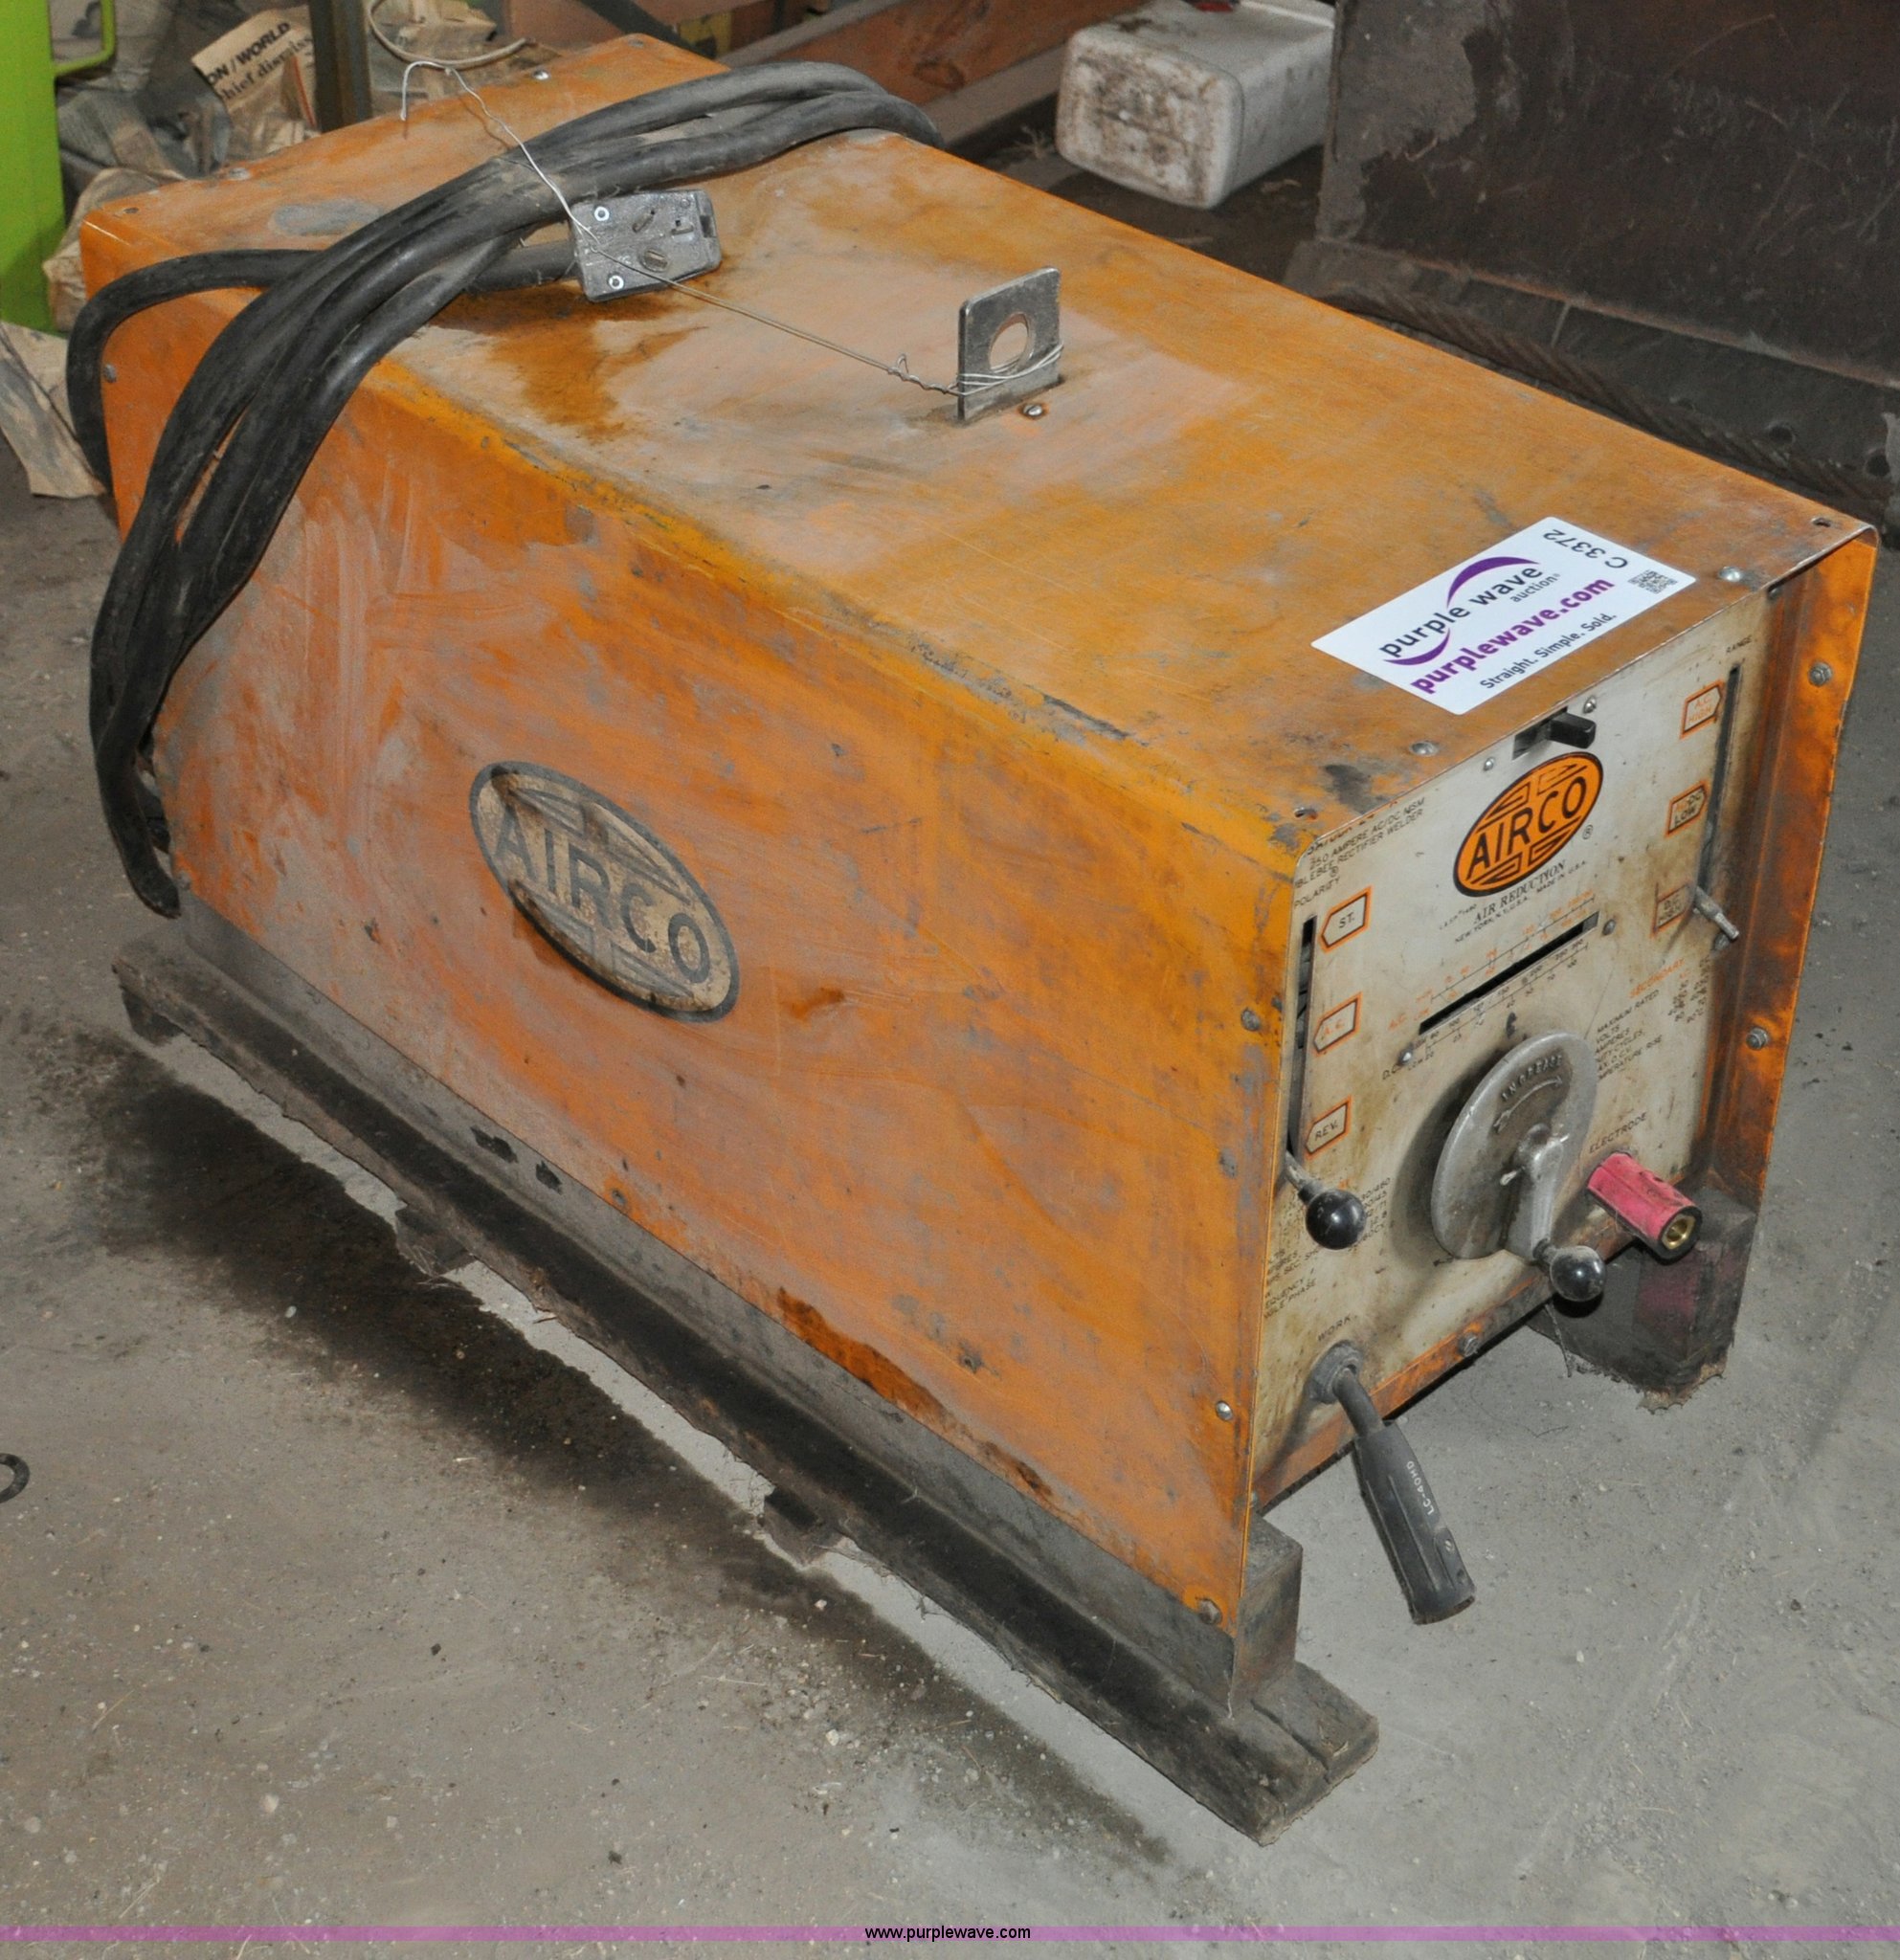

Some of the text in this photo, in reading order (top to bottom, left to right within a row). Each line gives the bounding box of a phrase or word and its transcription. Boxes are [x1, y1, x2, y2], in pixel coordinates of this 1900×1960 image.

[235, 22, 290, 65] WORLD
[220, 72, 255, 100] hief
[1543, 528, 1628, 569] C 3372
[1378, 566, 1544, 658] purple wave
[1410, 576, 1616, 695] purplewave.com
[1480, 613, 1618, 690] Straight. Simple. Sold.
[1331, 829, 1369, 858] AMPERE
[1372, 811, 1400, 835] AC/DC
[1337, 832, 1384, 863] RECTIFIER
[1387, 808, 1424, 835] WELDER
[1465, 776, 1587, 880] AIRCO
[1675, 808, 1696, 825] LOW
[493, 802, 711, 984] AIRCO
[1294, 878, 1340, 908] POLARITY
[1473, 902, 1496, 924] AIR
[1500, 859, 1567, 908] REDUCTION
[1338, 911, 1355, 928] ST.
[1454, 930, 1471, 944] NEW
[1598, 1006, 1632, 1033] MAXIMUM
[1635, 989, 1660, 1010] RATED
[1596, 1024, 1620, 1043] VOLTS
[1314, 1121, 1338, 1142] REV.
[1590, 1112, 1646, 1154] ELECTRODE
[1318, 1315, 1351, 1342] WORK
[1406, 1460, 1435, 1515] LC-40HD
